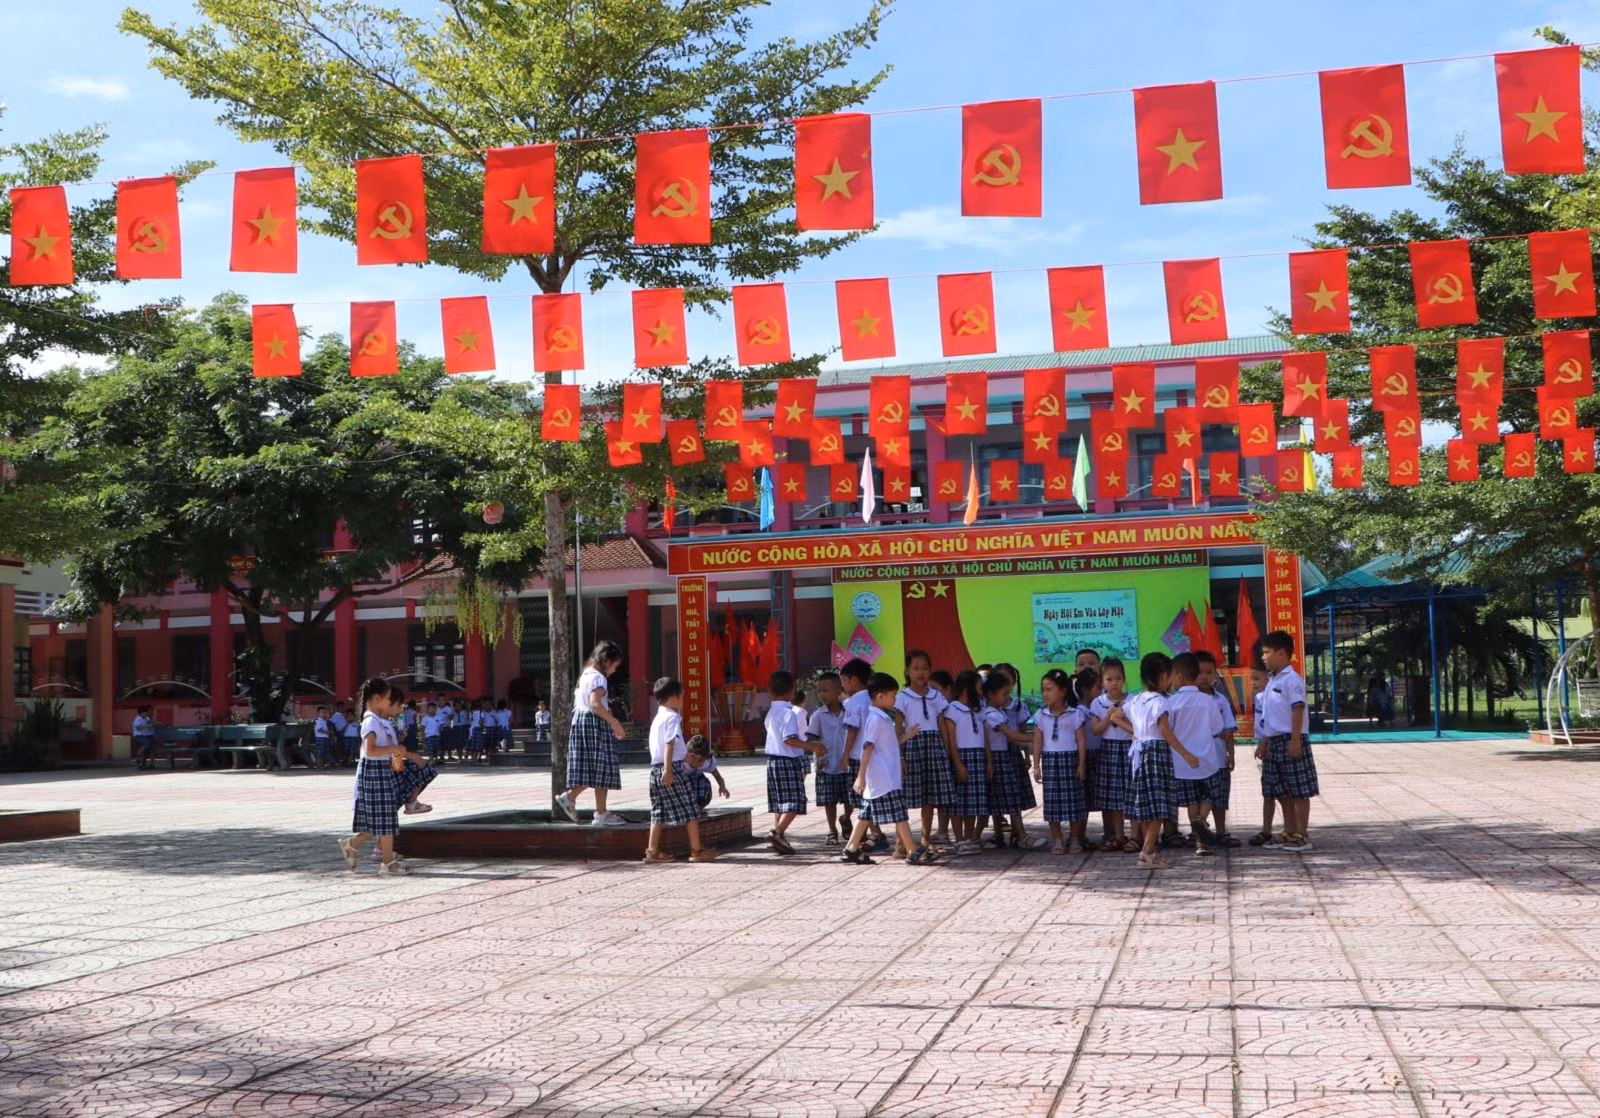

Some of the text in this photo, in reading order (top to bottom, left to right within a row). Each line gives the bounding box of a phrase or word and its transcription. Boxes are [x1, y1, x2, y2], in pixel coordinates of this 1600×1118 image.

[703, 547, 752, 565] NƯỚC
[757, 545, 807, 564] CỘNG
[813, 542, 852, 559] HÒA
[858, 540, 882, 556] XÃ
[889, 538, 923, 557] HỘI
[929, 533, 968, 553] CHỦ
[976, 532, 1034, 550] NGHĨA
[1041, 529, 1085, 548] VIỆT
[1093, 529, 1137, 545] NAM
[1143, 523, 1204, 542] MUÔN
[841, 553, 1197, 578] NƯỚC CỘNG HÒA XÃ HỘI CHỦ NGHĨA VIỆT NAM MUÔN NĂM!
